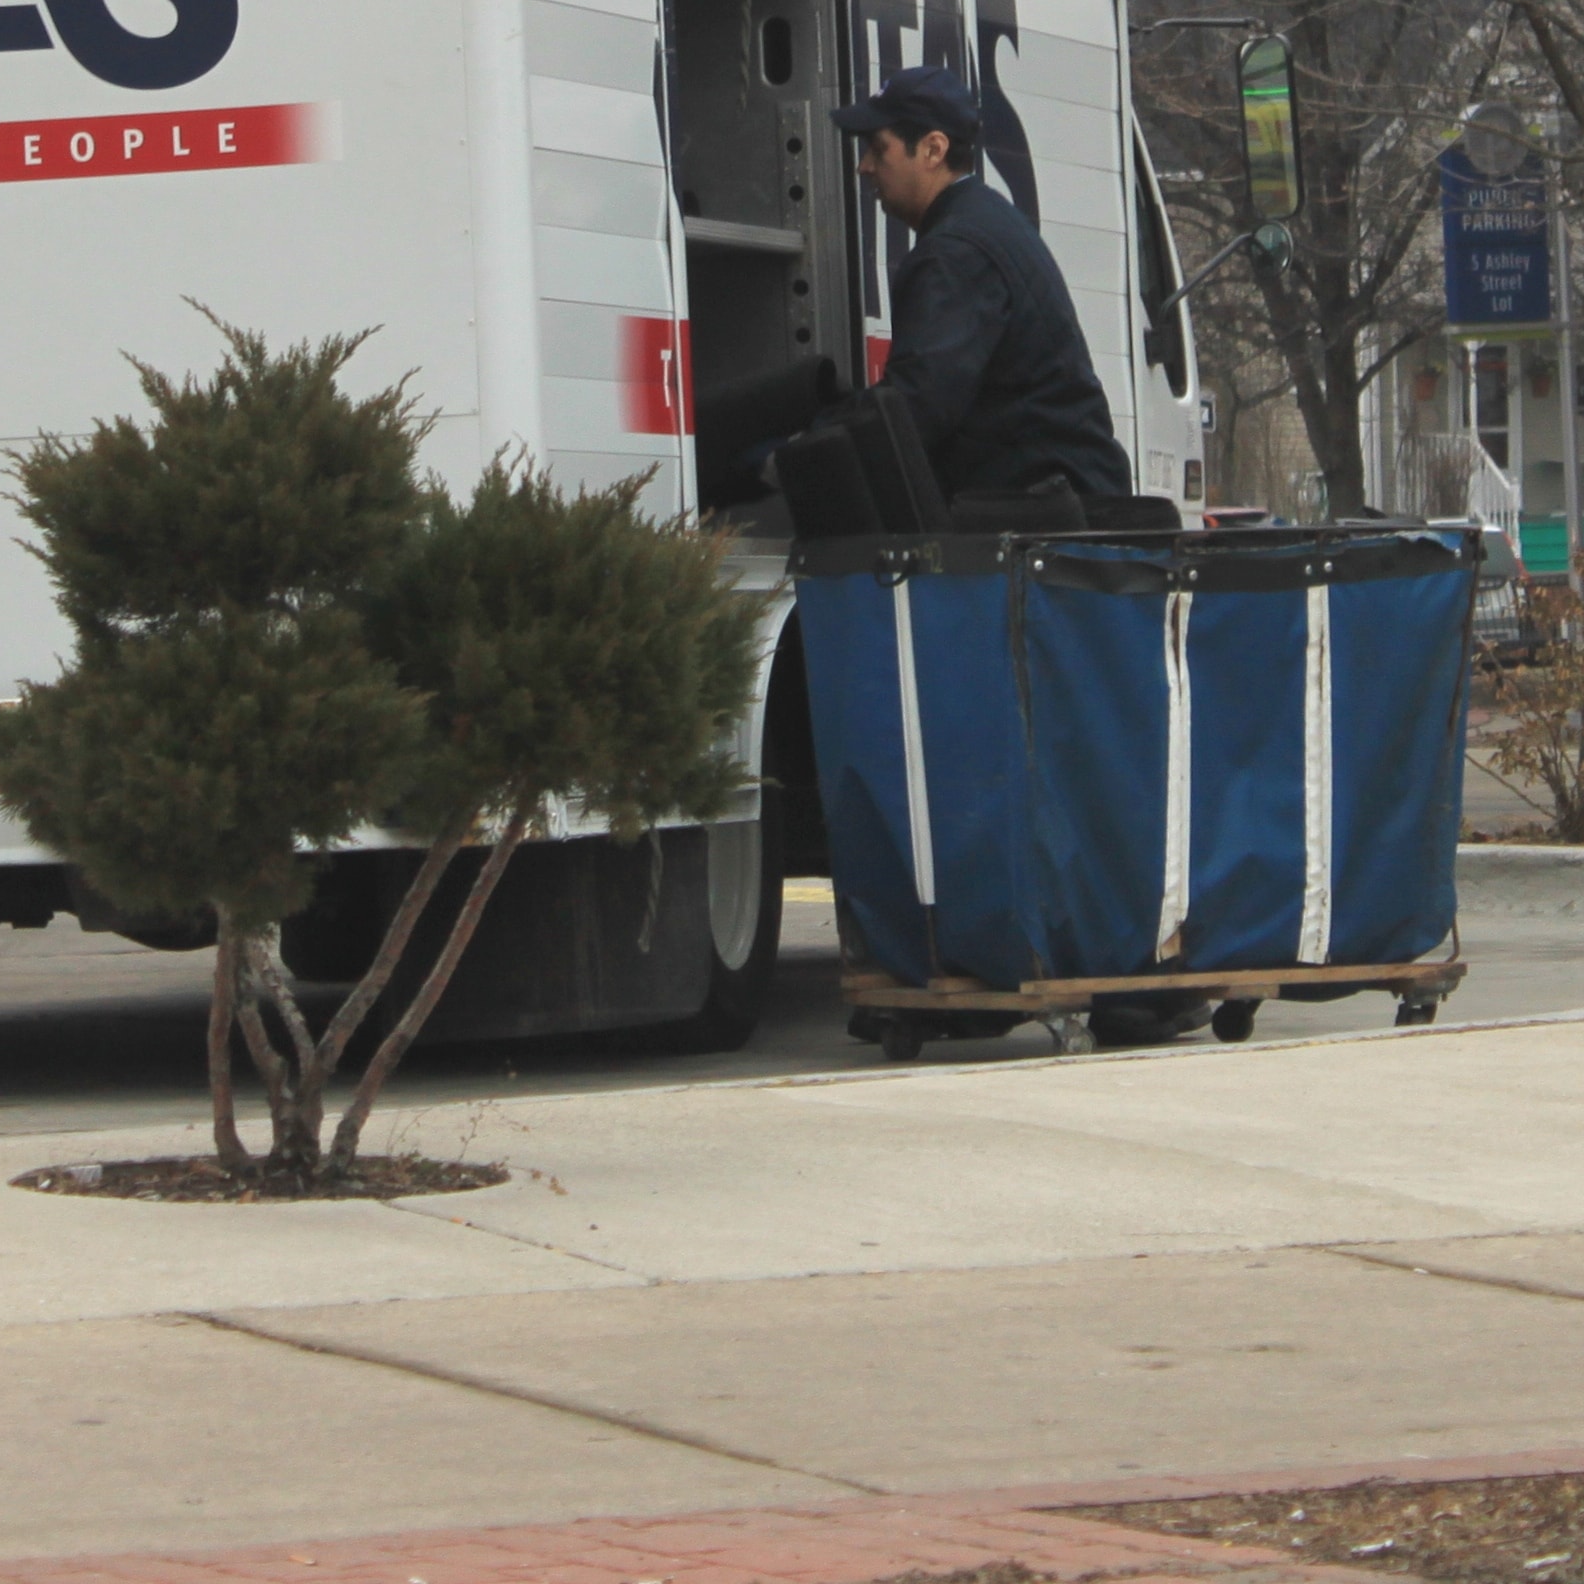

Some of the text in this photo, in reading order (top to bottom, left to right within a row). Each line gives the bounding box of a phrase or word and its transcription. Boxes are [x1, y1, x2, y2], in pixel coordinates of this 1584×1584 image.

[1485, 253, 1531, 273] Ashley
[1481, 274, 1523, 293] Street
[1491, 295, 1513, 313] Lot
